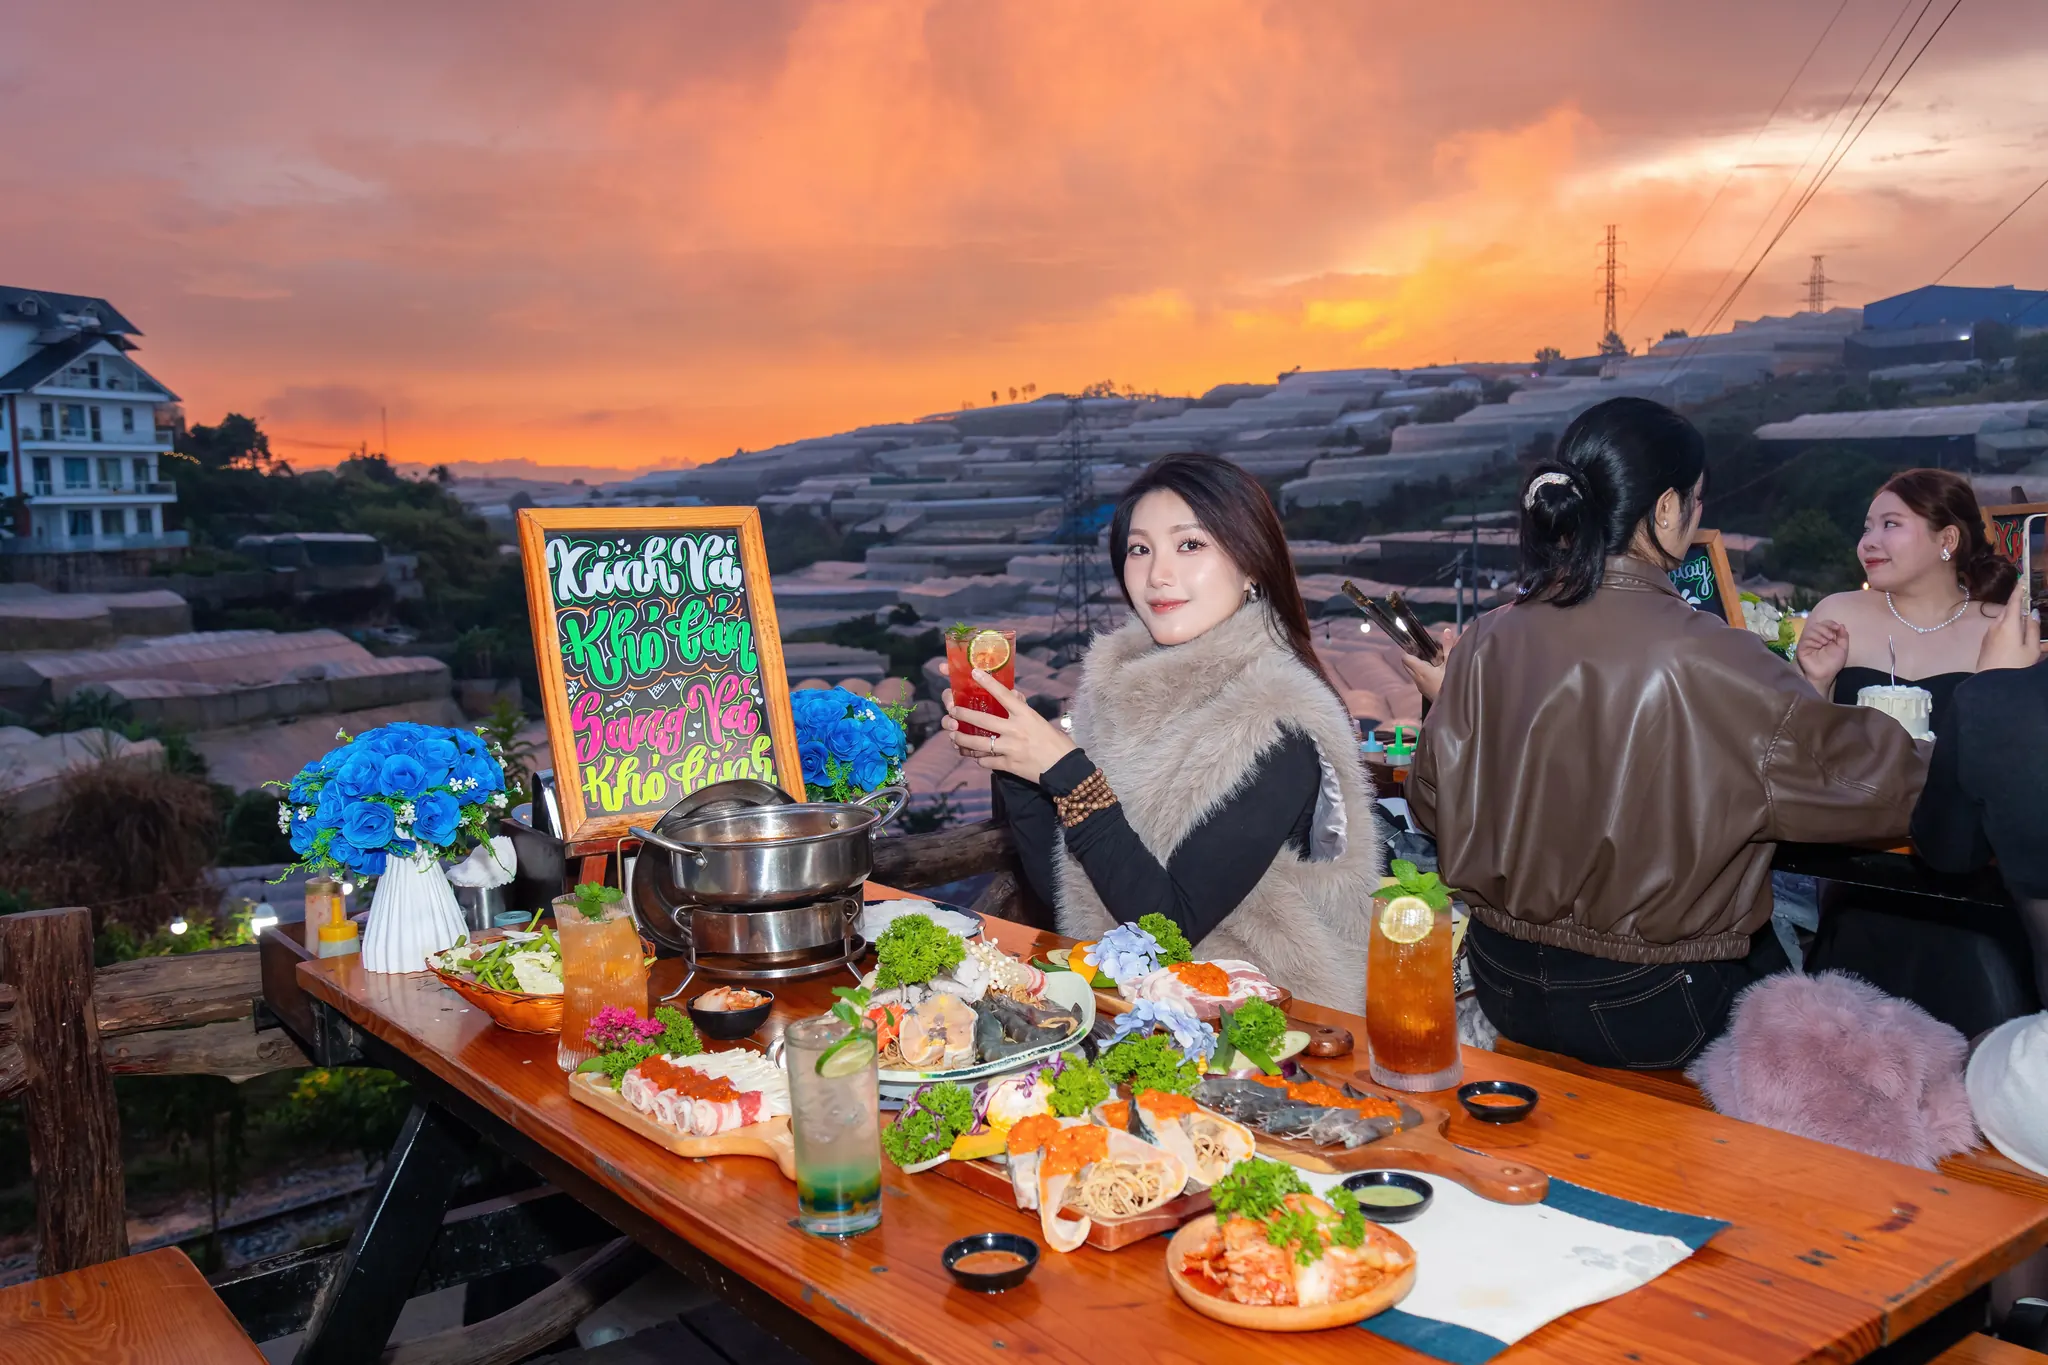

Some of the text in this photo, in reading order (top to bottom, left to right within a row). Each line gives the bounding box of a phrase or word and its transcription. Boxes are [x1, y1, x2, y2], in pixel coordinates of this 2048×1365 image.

[561, 608, 664, 684] Khó
[571, 691, 688, 764] Sang
[582, 756, 666, 812] Khó
